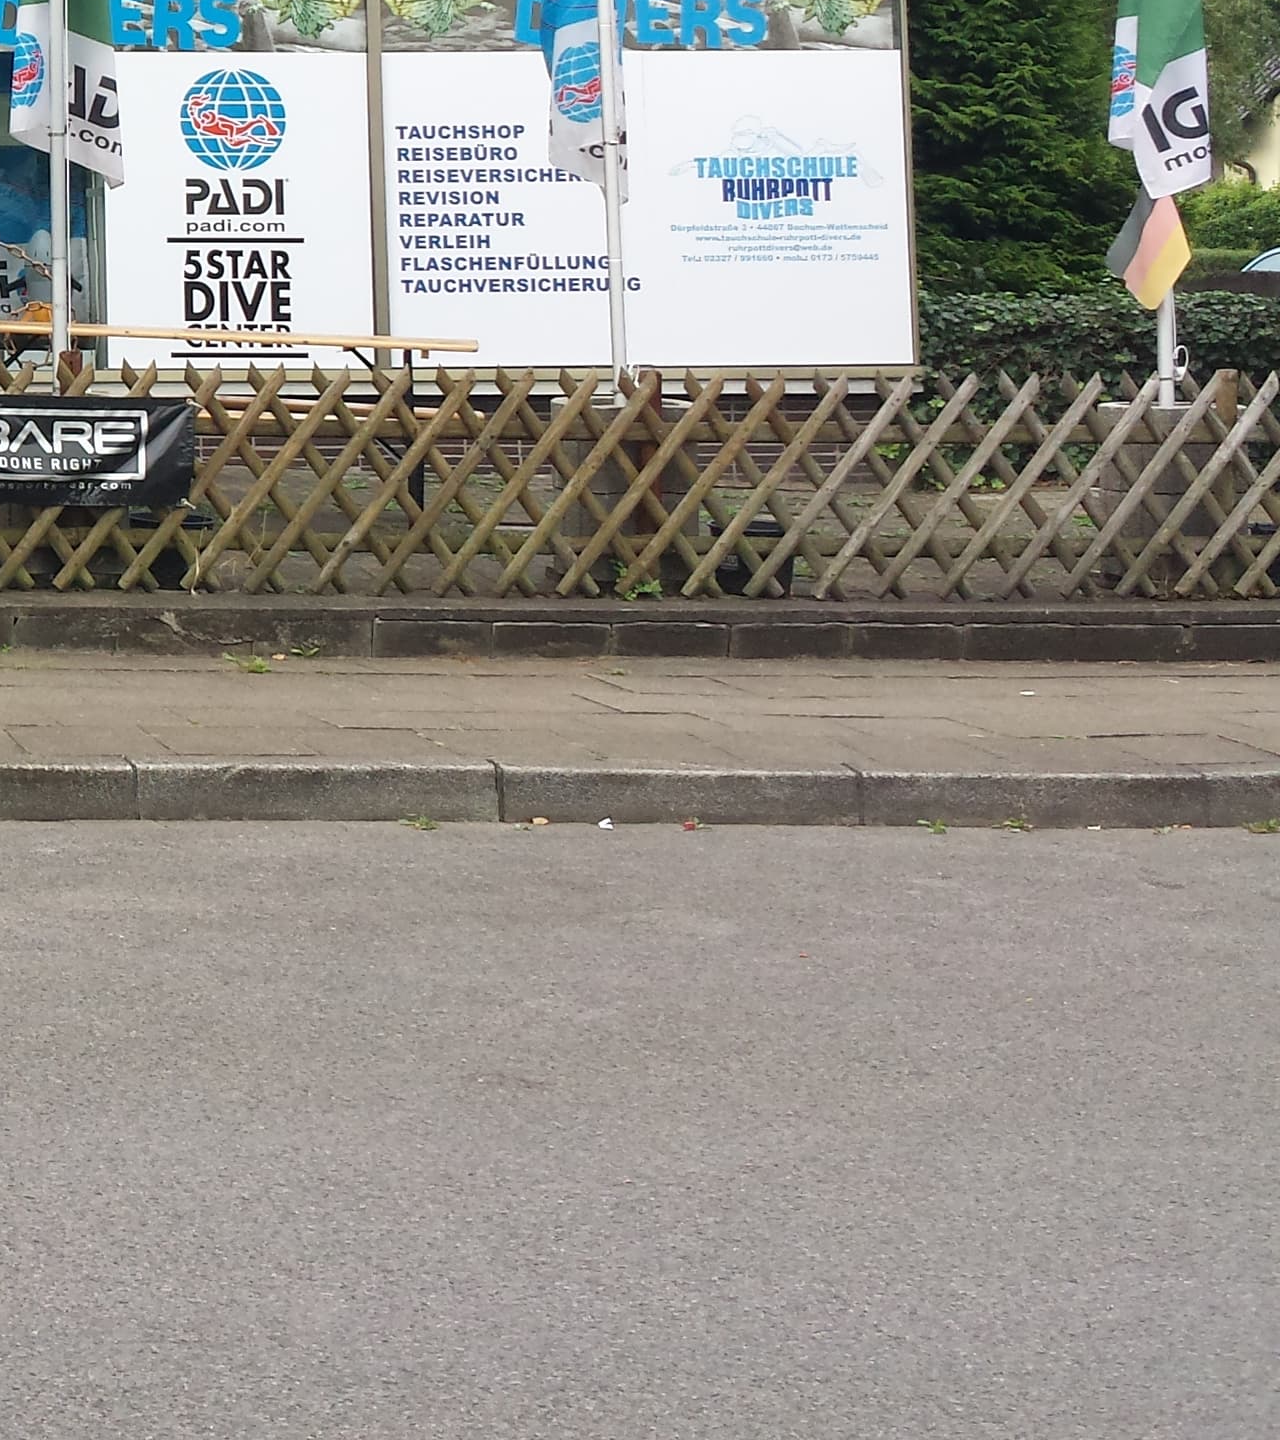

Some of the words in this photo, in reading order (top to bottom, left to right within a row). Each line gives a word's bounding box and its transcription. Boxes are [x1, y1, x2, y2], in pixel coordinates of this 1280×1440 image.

[396, 125, 525, 139] TAUCHSHOP
[397, 144, 518, 161] REISEBÜRO
[694, 156, 858, 178] TAUCHSCHULE
[398, 168, 591, 183] REISEVERSICHER
[185, 178, 285, 216] PADI
[399, 191, 500, 205] REVISION
[722, 178, 834, 202] RUHRPOTT
[736, 198, 814, 220] DIVERS
[186, 219, 286, 235] padi.com
[400, 212, 525, 227] REPARATUR
[400, 235, 491, 249] VERLEIH
[401, 254, 609, 271] FLASCHENFÜLLUNG
[401, 277, 641, 293] TAUCHVERSICHERUG
[184, 281, 292, 322] DIVE
[51, 458, 102, 470] RIGHT
